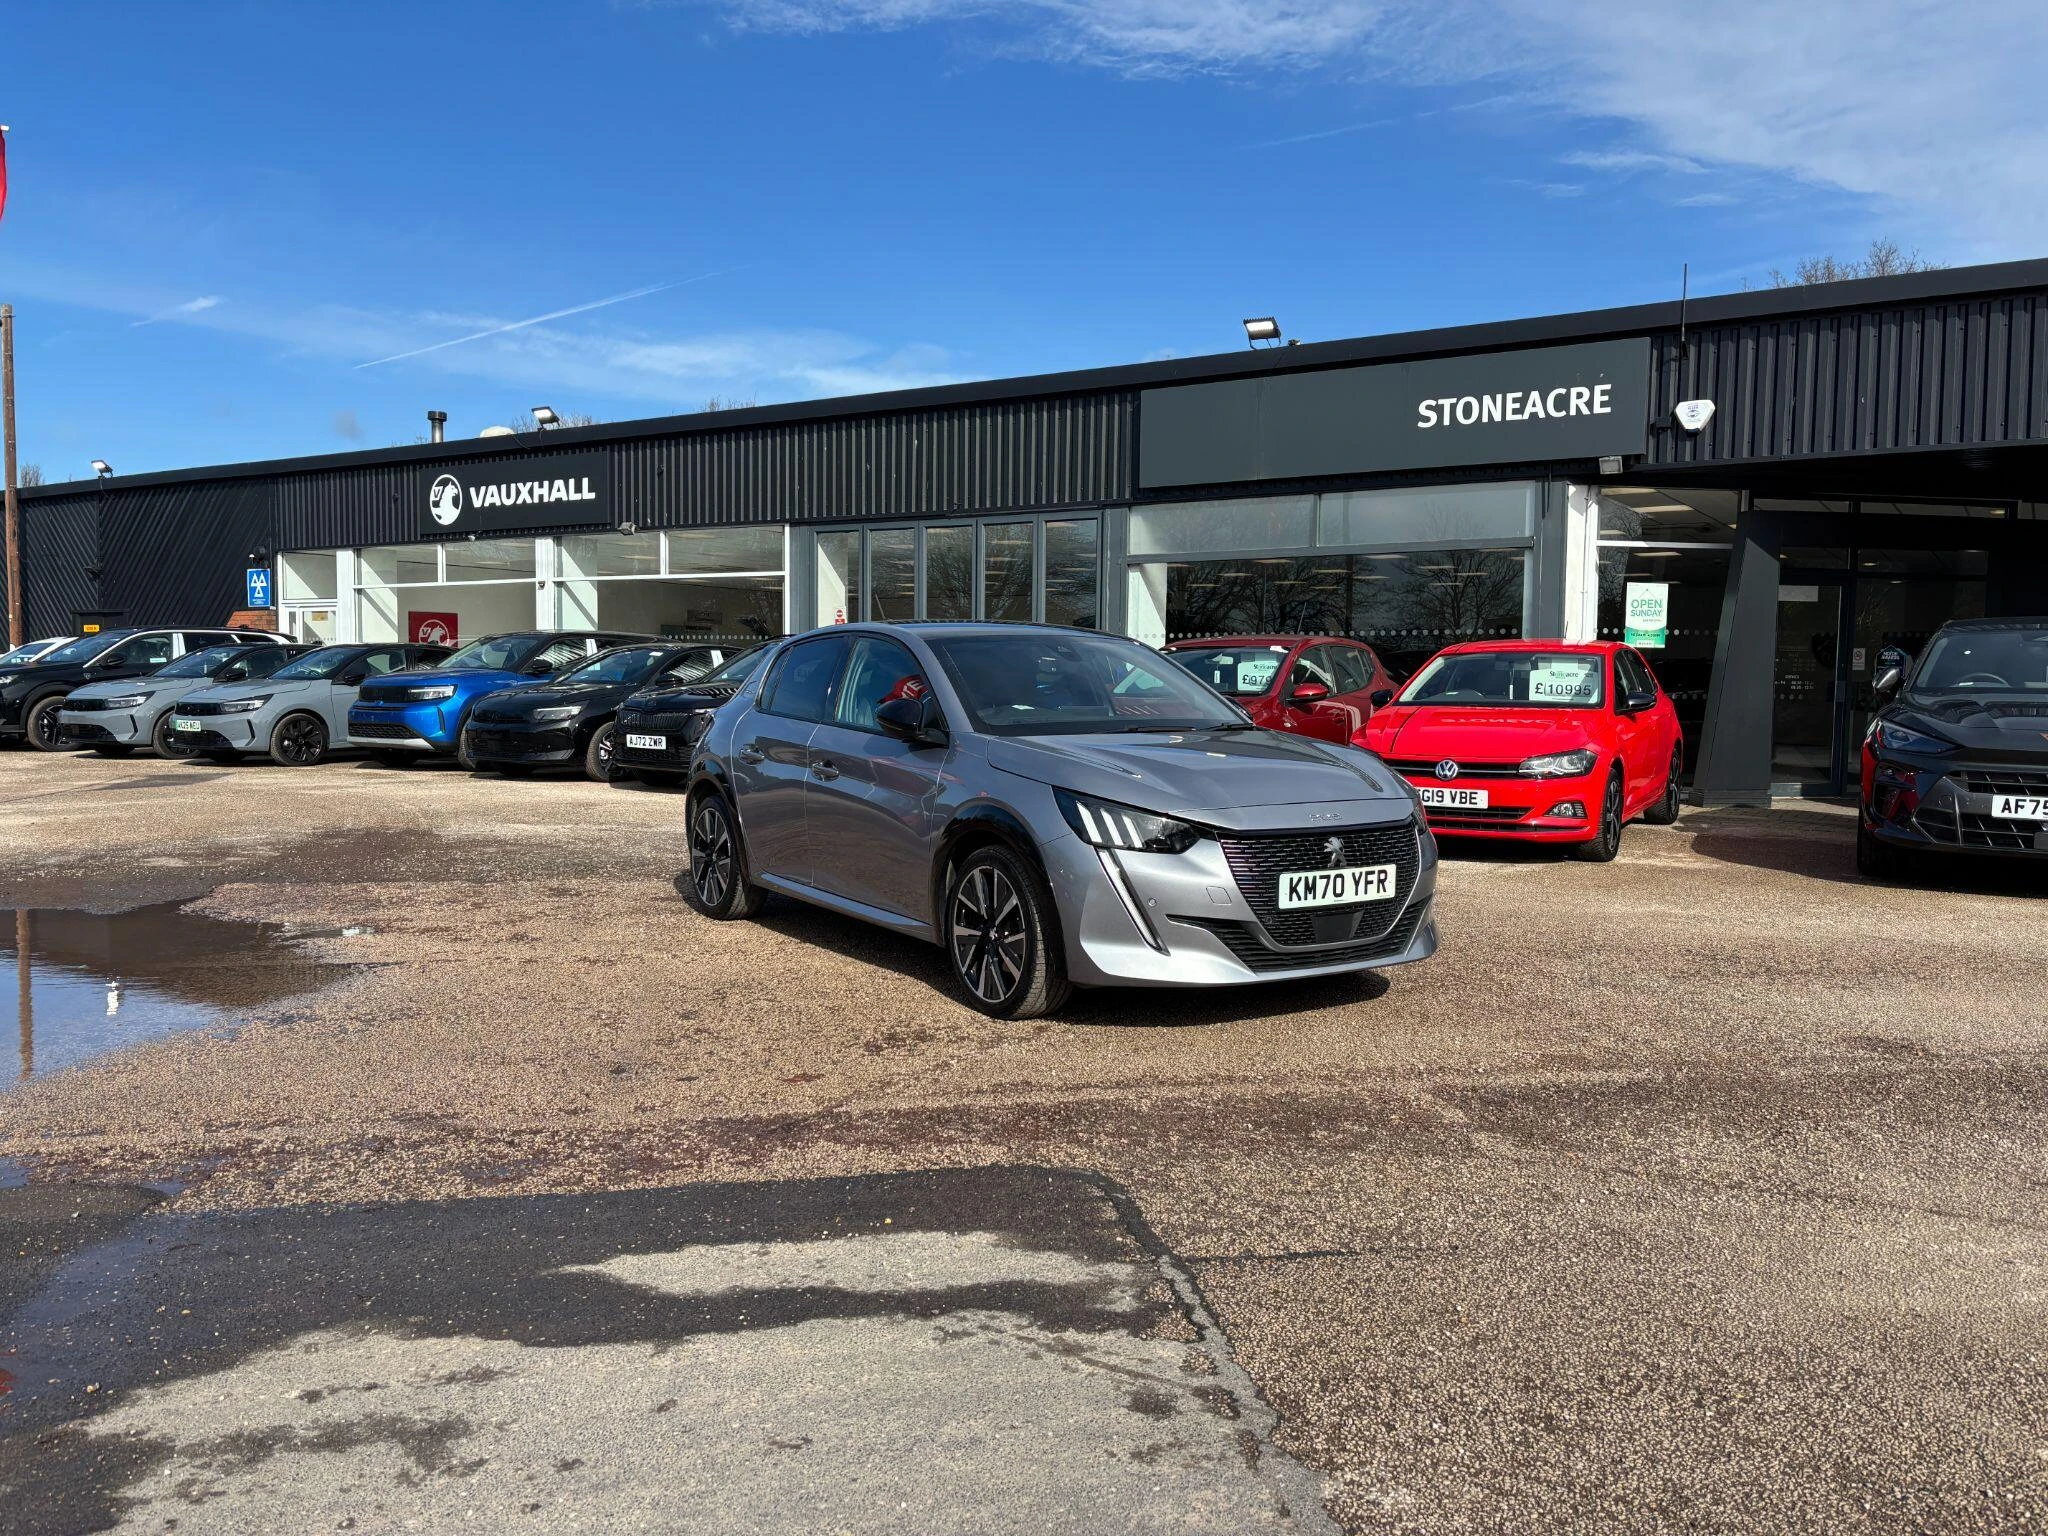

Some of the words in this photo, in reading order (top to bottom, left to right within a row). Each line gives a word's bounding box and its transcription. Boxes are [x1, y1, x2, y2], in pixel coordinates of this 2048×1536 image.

[1417, 384, 1612, 428] STONEACRE
[469, 477, 596, 508] VAUXHALL
[1631, 599, 1663, 609] OPEN
[1630, 609, 1663, 617] SUNDAY
[1535, 682, 1591, 696] £10995
[629, 735, 647, 747] AJ72
[648, 736, 663, 748] ZWR
[1418, 788, 1445, 803] G19
[1450, 790, 1479, 805] VBE
[1289, 873, 1345, 902] KM70
[1352, 869, 1388, 897] YFR
